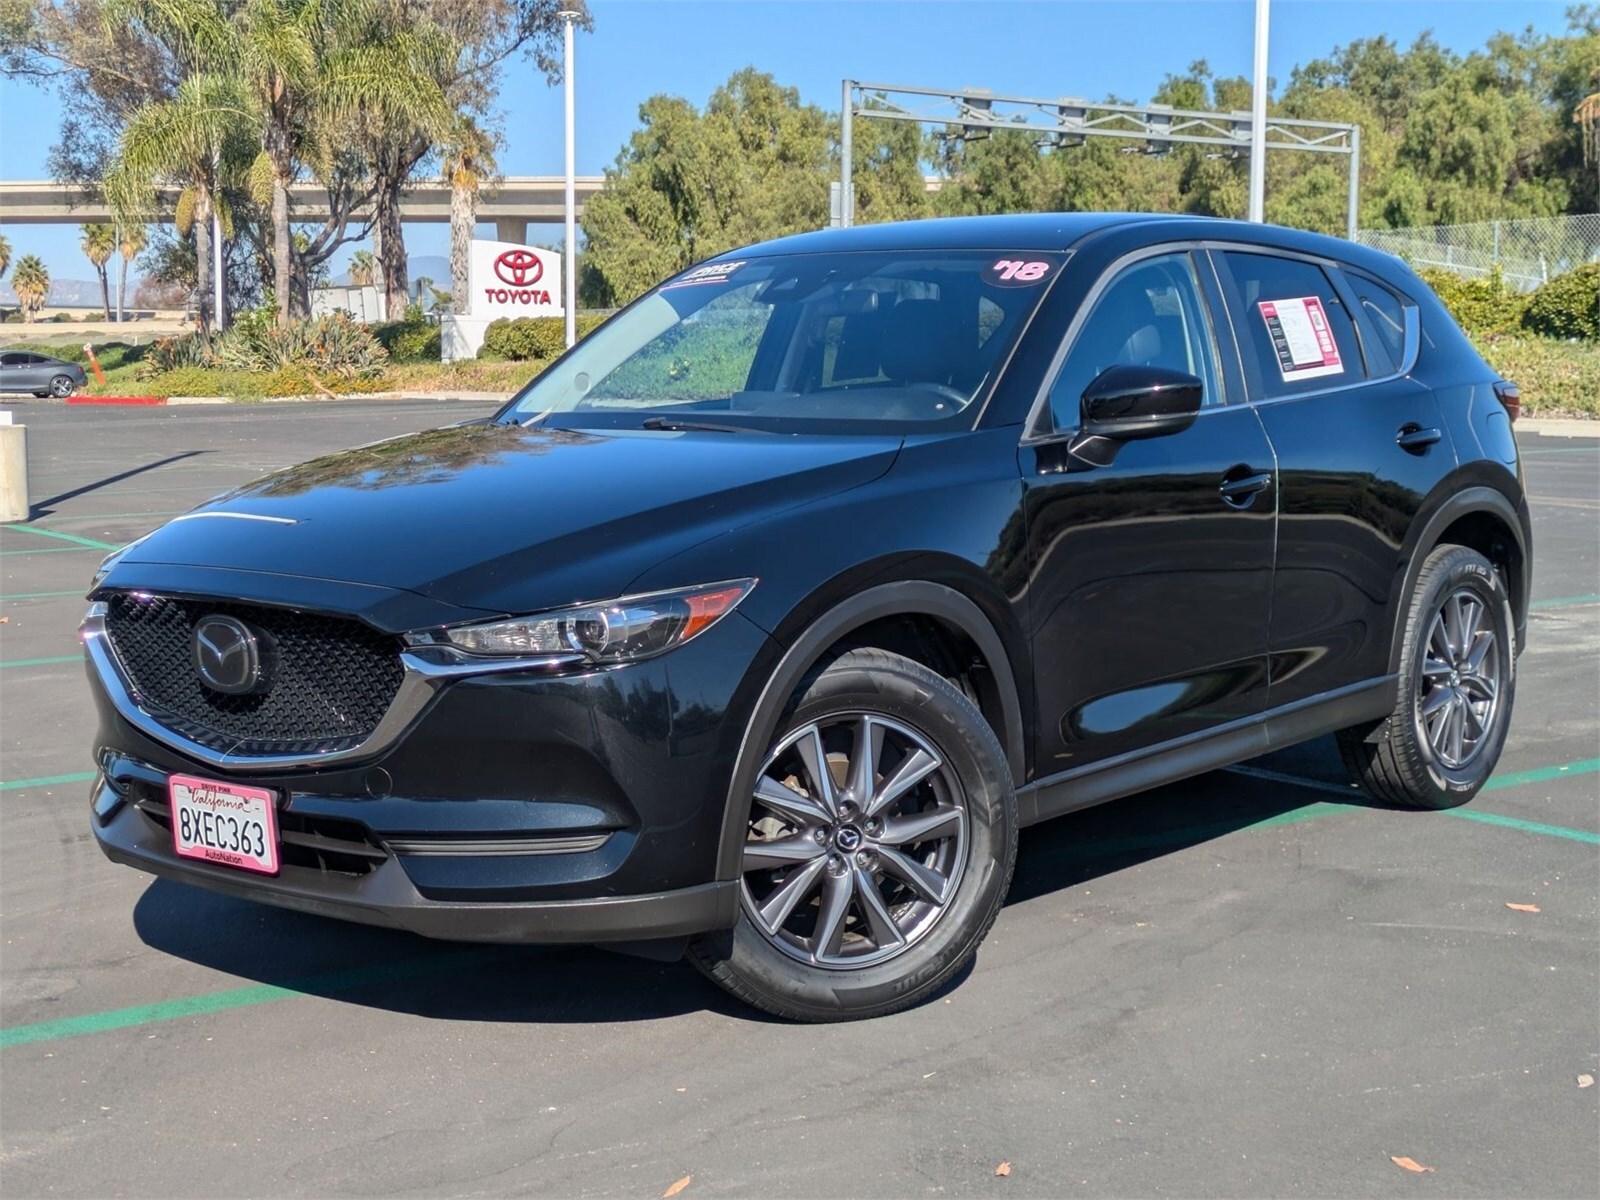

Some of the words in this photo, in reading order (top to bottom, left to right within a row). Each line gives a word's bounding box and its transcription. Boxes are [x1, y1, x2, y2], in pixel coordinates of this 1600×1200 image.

[993, 260, 1050, 281] '18
[485, 288, 552, 305] TOYOTA
[201, 783, 218, 792] DRIVE
[218, 786, 231, 794] PINK
[191, 788, 251, 813] California
[180, 807, 265, 858] 8XEC363
[204, 849, 243, 865] AutoNation
